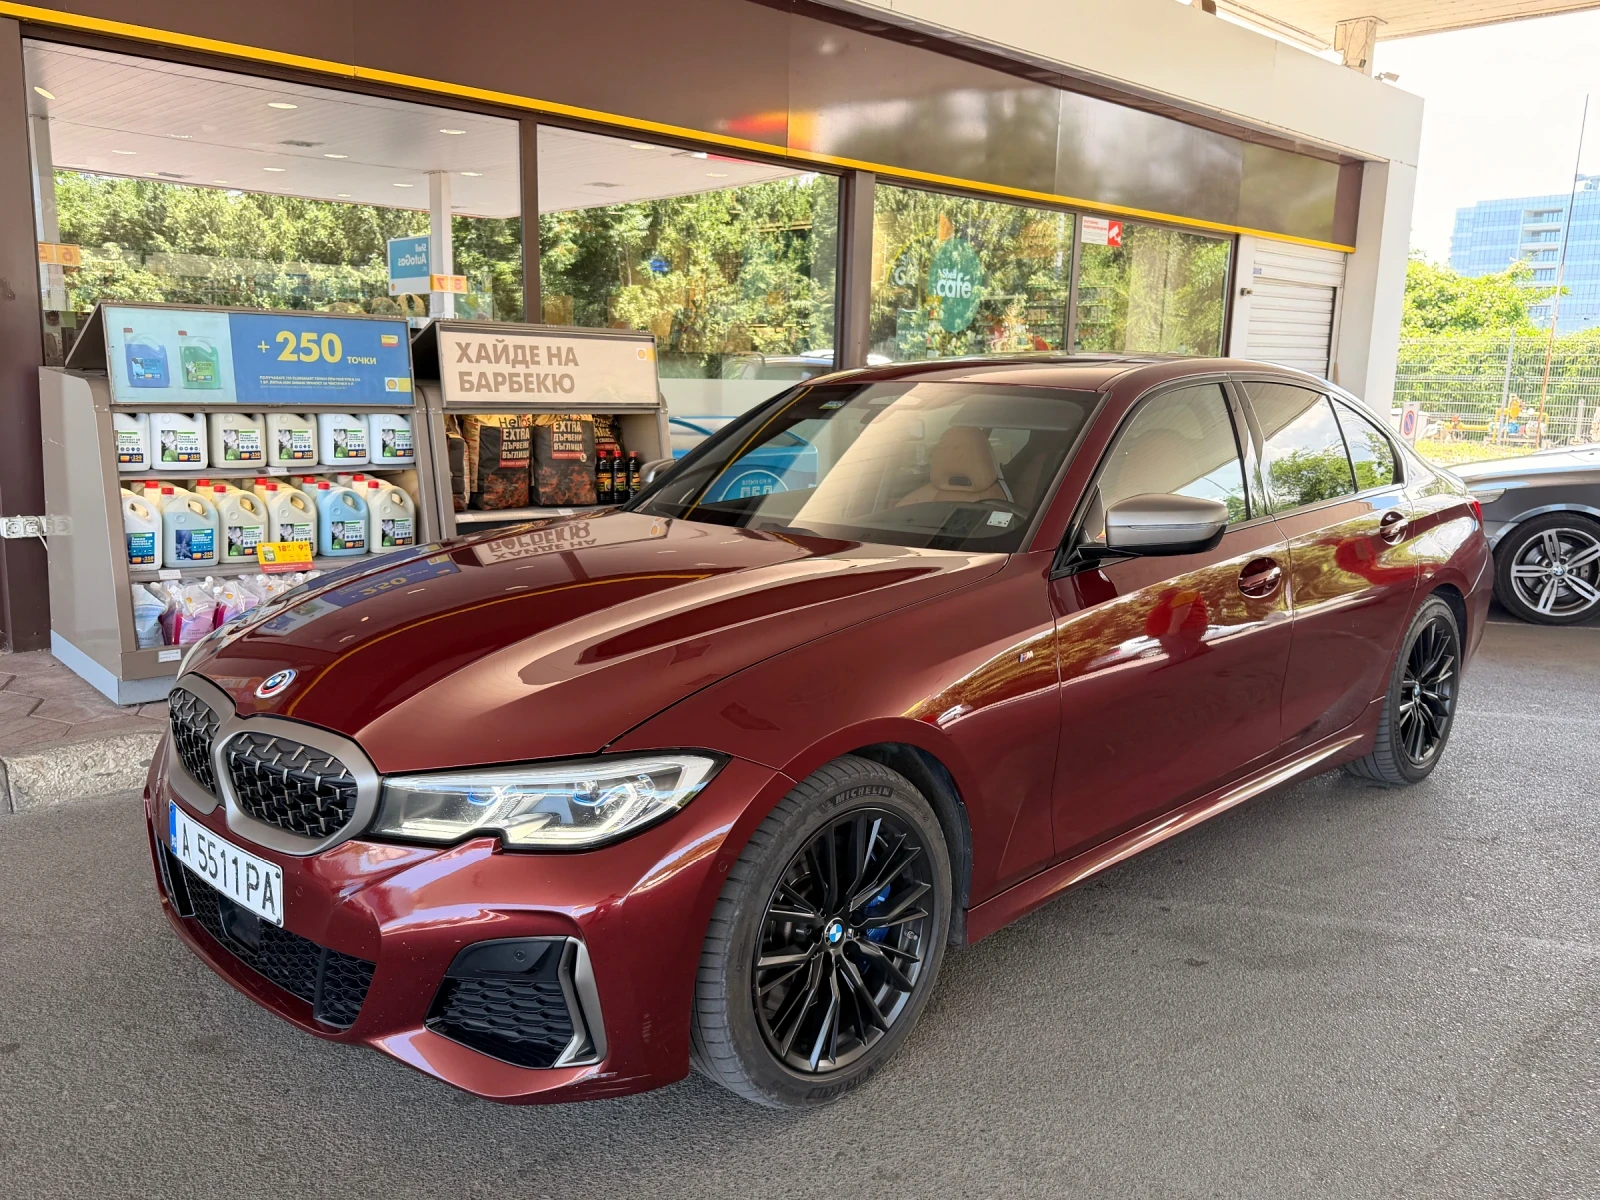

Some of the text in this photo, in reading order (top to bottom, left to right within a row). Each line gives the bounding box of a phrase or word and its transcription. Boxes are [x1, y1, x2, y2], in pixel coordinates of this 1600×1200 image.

[942, 266, 957, 280] Shell
[936, 272, 972, 299] café
[456, 338, 579, 369] ХАЙДЕ НА
[459, 371, 575, 394] БАРБЕКЮ
[498, 416, 531, 428] Helios
[553, 420, 582, 432] EXTRA
[503, 428, 530, 440] EXTRA
[553, 433, 582, 442] ДЪРВЕНИ
[553, 442, 583, 451] ВЪГЛИЩА
[835, 785, 890, 804] MICHELIN
[182, 822, 276, 915] A 5511 PA
